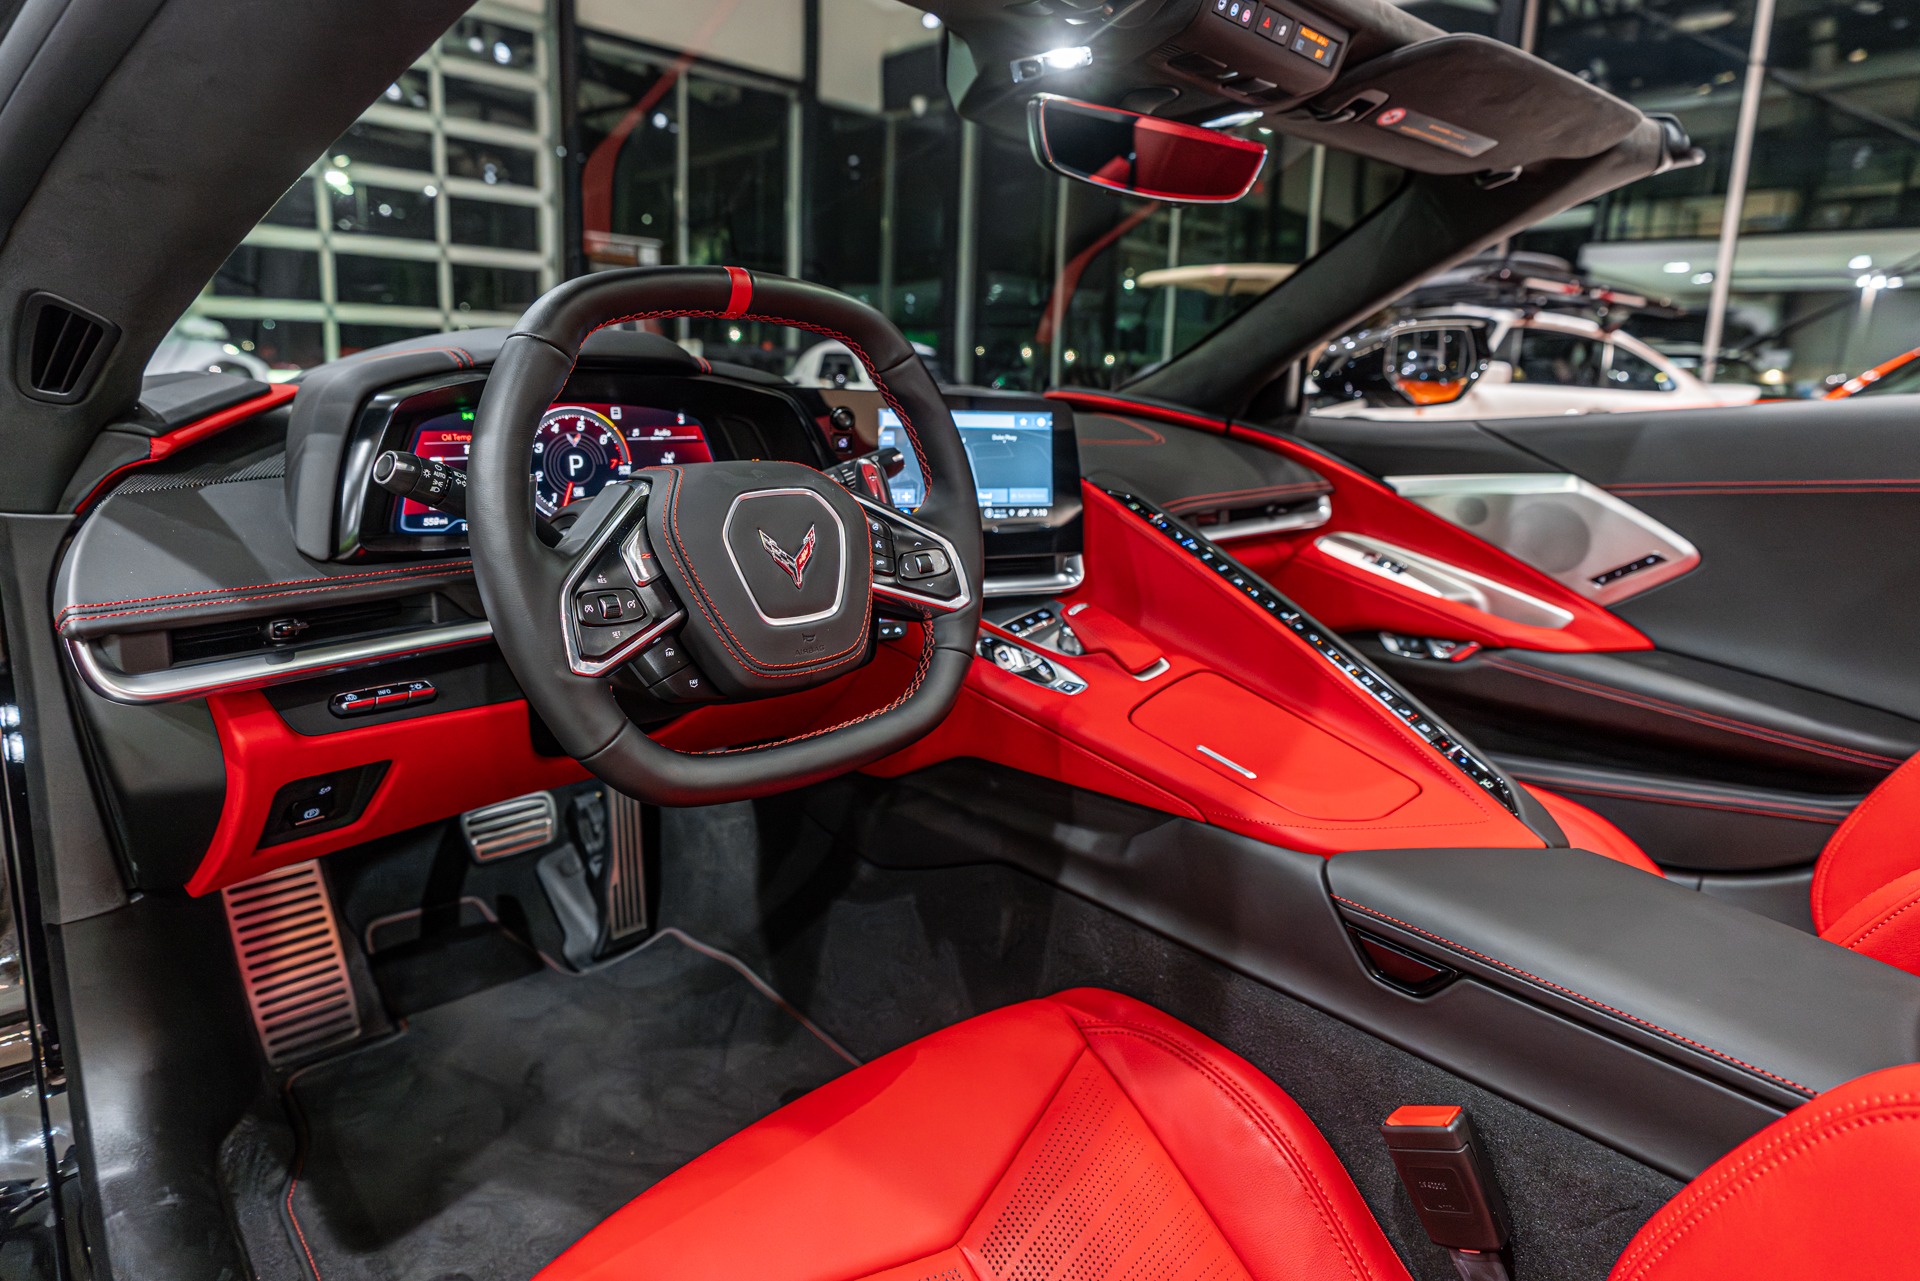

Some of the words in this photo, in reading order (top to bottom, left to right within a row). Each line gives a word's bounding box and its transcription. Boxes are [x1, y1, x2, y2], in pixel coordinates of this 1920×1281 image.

[550, 423, 560, 434] 4
[576, 421, 585, 431] 5
[599, 434, 608, 445] 6
[534, 442, 544, 453] 3
[568, 455, 584, 477] P
[610, 458, 618, 469] 7
[433, 470, 446, 480] AUTO
[535, 471, 544, 482] 2
[551, 492, 558, 503] 1
[665, 649, 675, 657] FAV
[795, 644, 826, 657] AIRBAG
[689, 678, 699, 686] FAV
[344, 693, 358, 702] HUD
[377, 688, 392, 696] INFO
